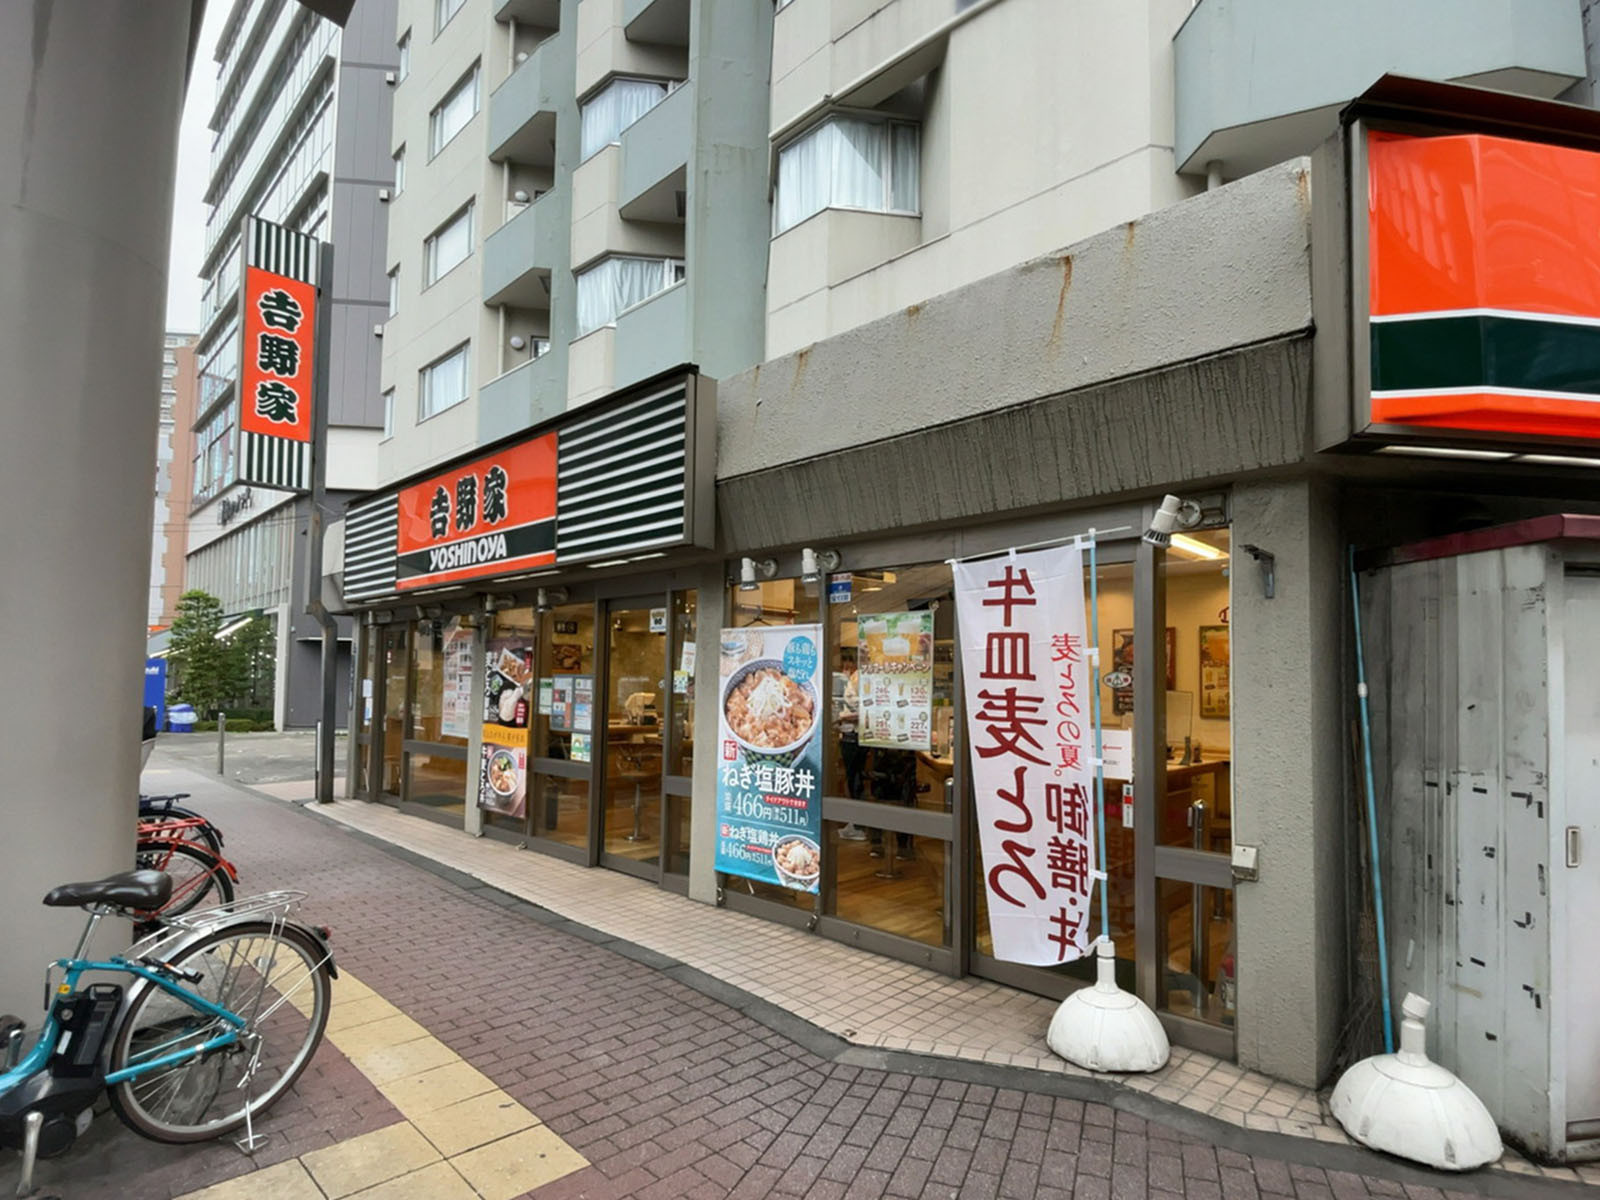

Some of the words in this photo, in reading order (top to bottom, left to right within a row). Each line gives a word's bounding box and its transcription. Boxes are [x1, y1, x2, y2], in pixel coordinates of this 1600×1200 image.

[257, 288, 303, 425] 吉野家
[429, 464, 508, 540] 吉野家
[429, 533, 508, 572] YOSHINOYA
[723, 765, 815, 798] ねぎ塩豚丼
